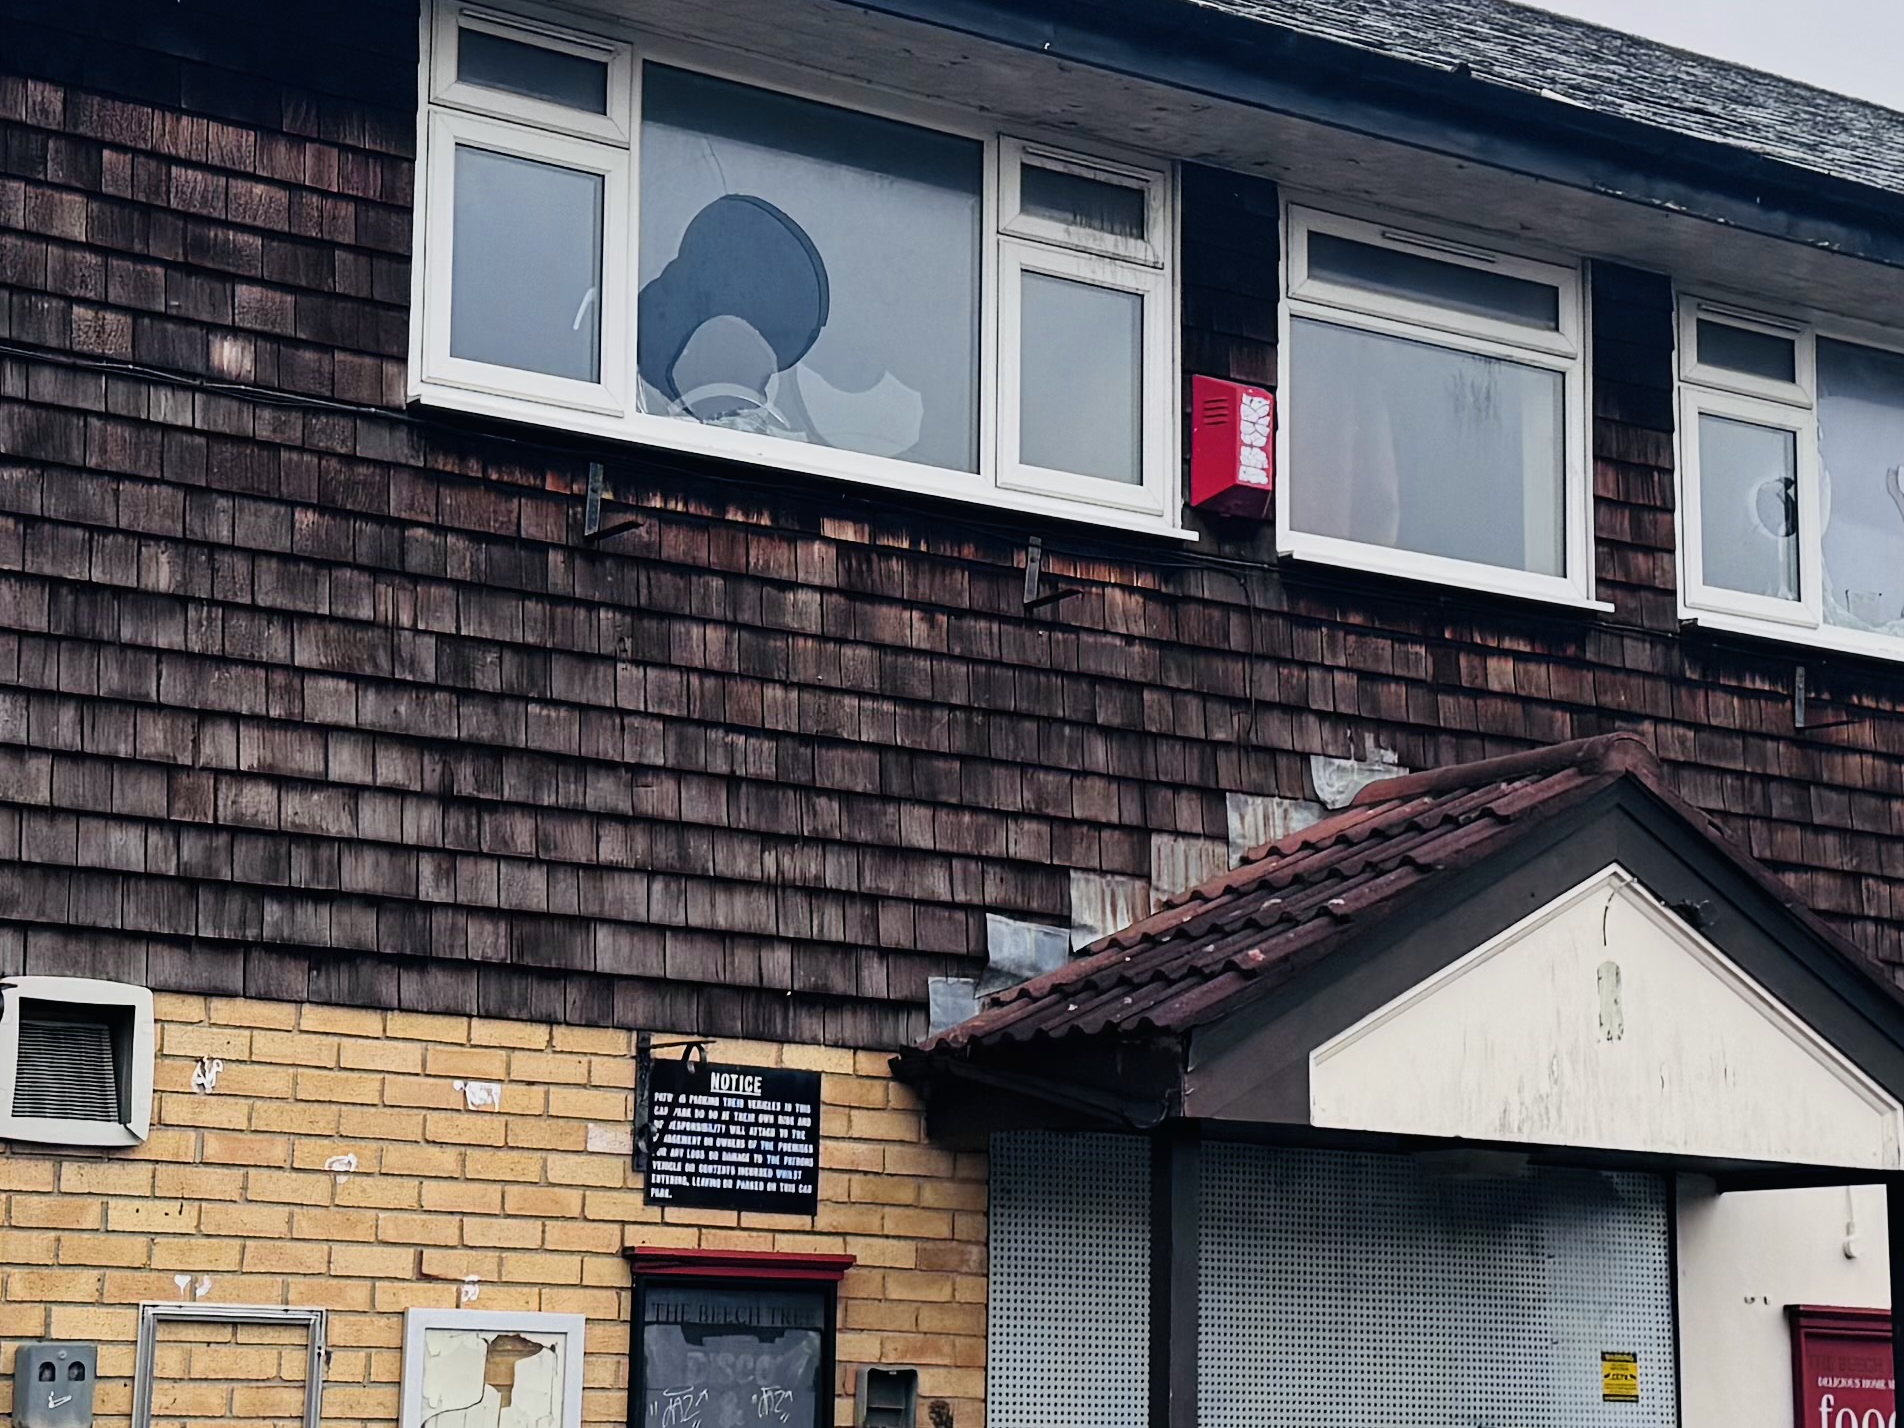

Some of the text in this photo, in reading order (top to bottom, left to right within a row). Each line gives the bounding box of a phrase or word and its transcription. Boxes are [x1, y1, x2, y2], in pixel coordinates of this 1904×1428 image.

[710, 1072, 763, 1095] NOTICE
[654, 1091, 686, 1104] PATRNS
[733, 1111, 756, 1123] THEIR
[791, 1128, 806, 1140] THE
[760, 1140, 774, 1152] THE
[652, 1146, 667, 1157] OR
[686, 1148, 705, 1160] LOSS
[766, 1154, 780, 1166] THE
[651, 1302, 688, 1322] THE
[698, 1304, 760, 1325] BEECH
